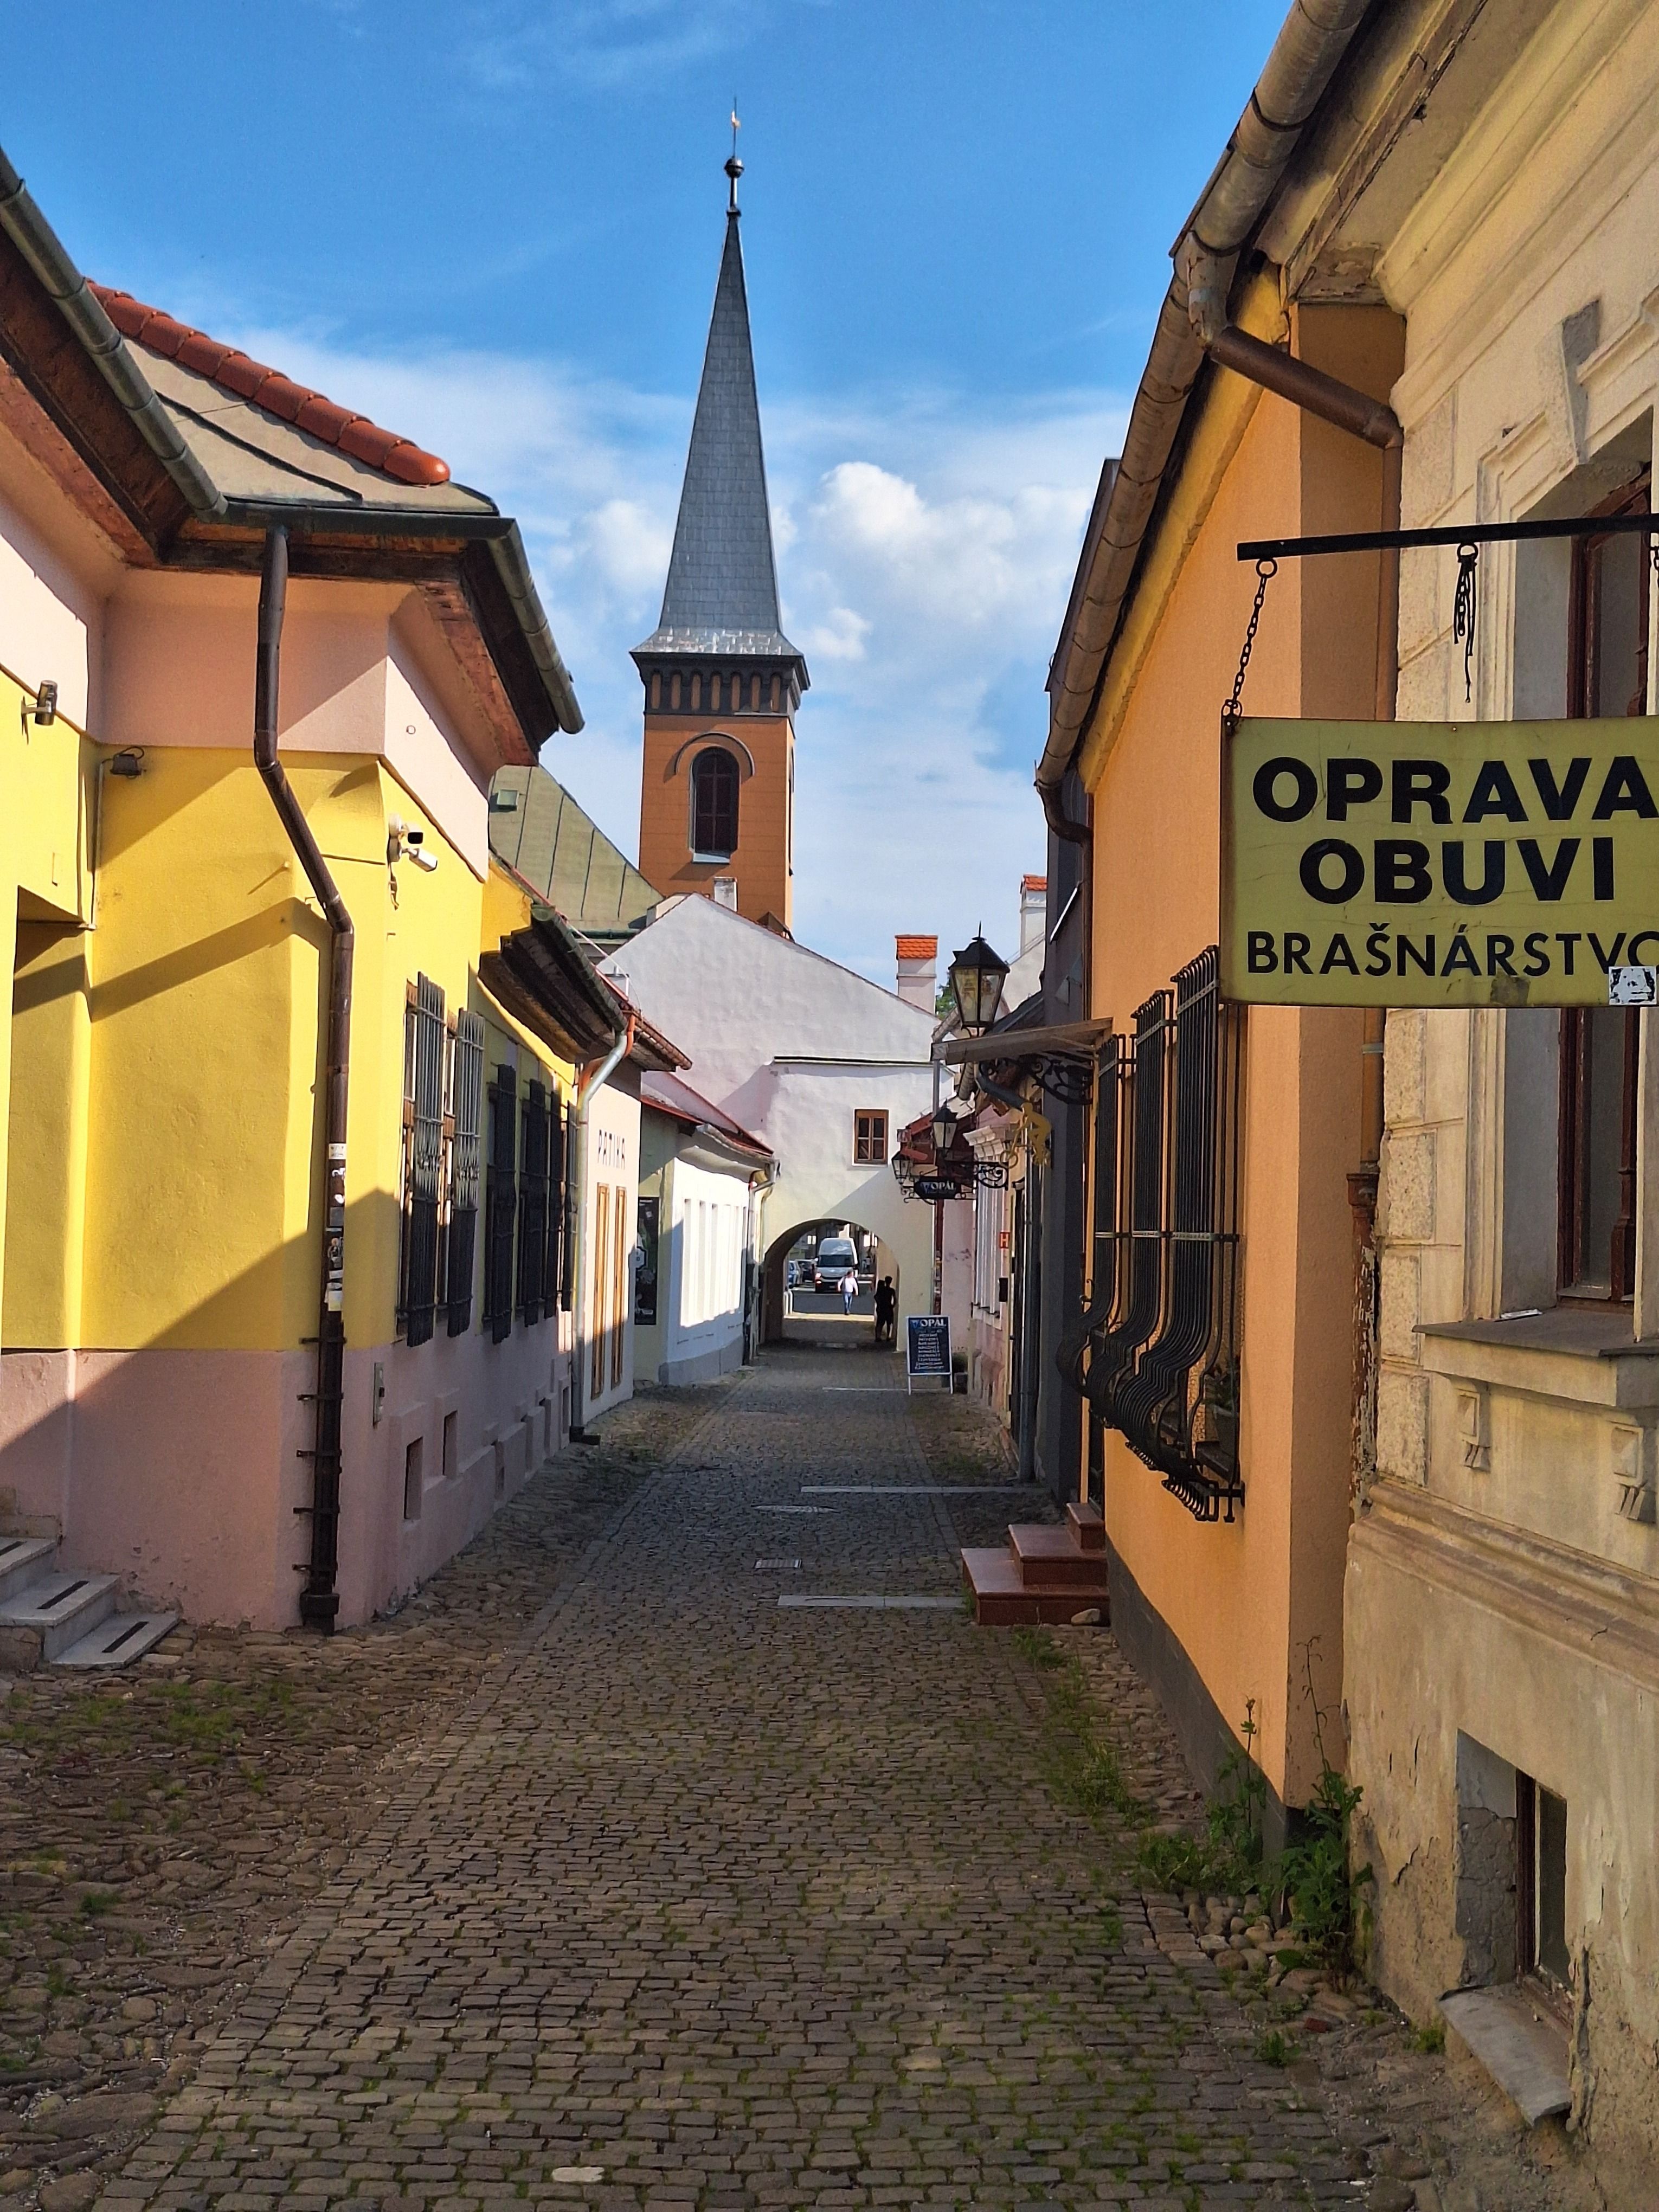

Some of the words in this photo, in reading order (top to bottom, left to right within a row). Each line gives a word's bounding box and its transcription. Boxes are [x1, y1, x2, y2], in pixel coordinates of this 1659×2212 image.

[1252, 756, 1659, 824] OPRAVA
[1299, 837, 1615, 905] OBUVI
[597, 1129, 625, 1170] PATIKA
[1000, 1233, 1008, 1248] H
